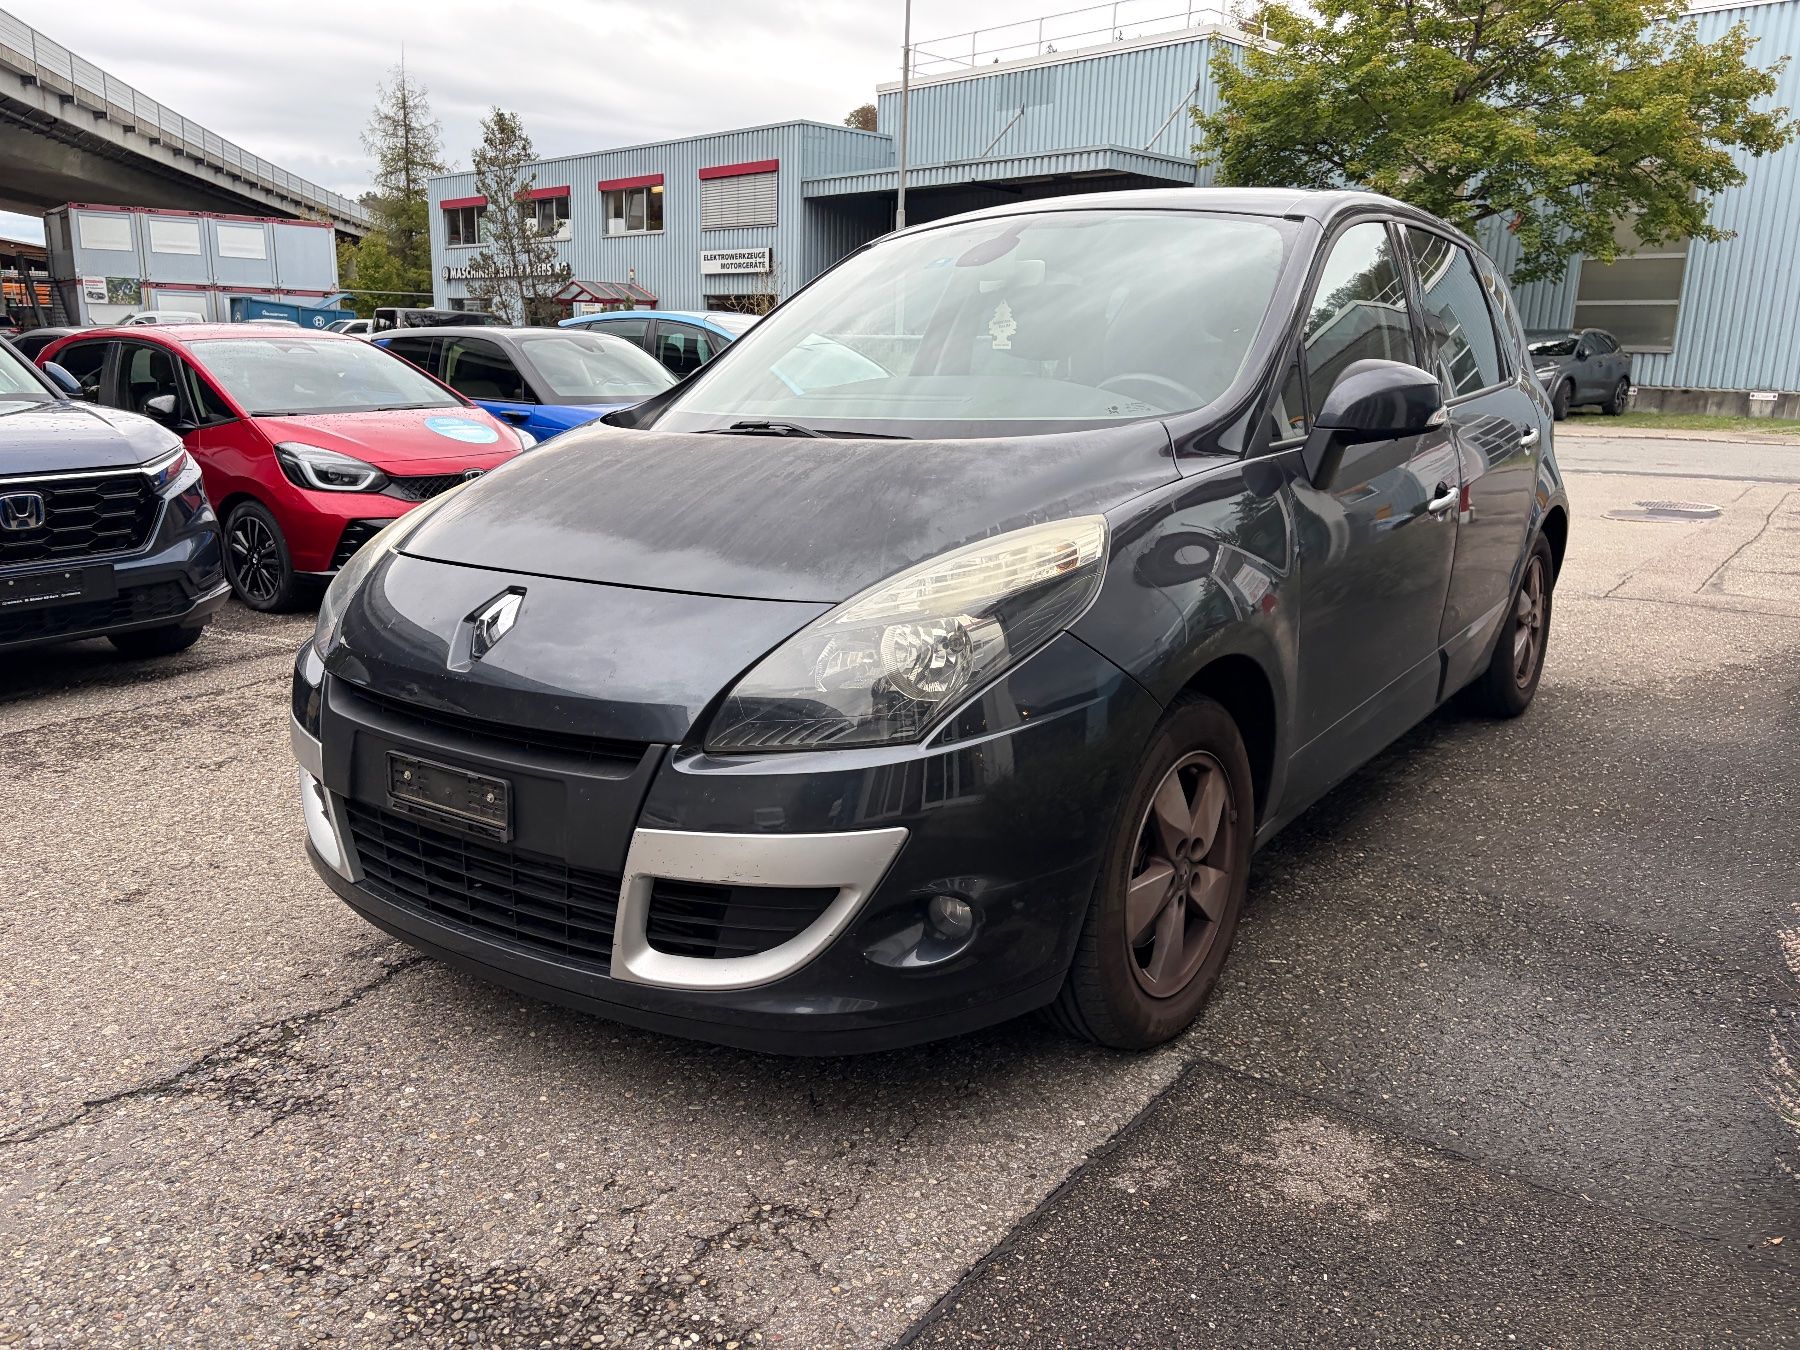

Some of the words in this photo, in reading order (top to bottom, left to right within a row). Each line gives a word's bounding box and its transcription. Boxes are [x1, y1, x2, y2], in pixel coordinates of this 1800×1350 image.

[703, 251, 766, 262] ELEKTROWERKZEUGE
[720, 260, 766, 270] MOTORGERÄTE
[450, 265, 524, 279] MASCHINENENTR
